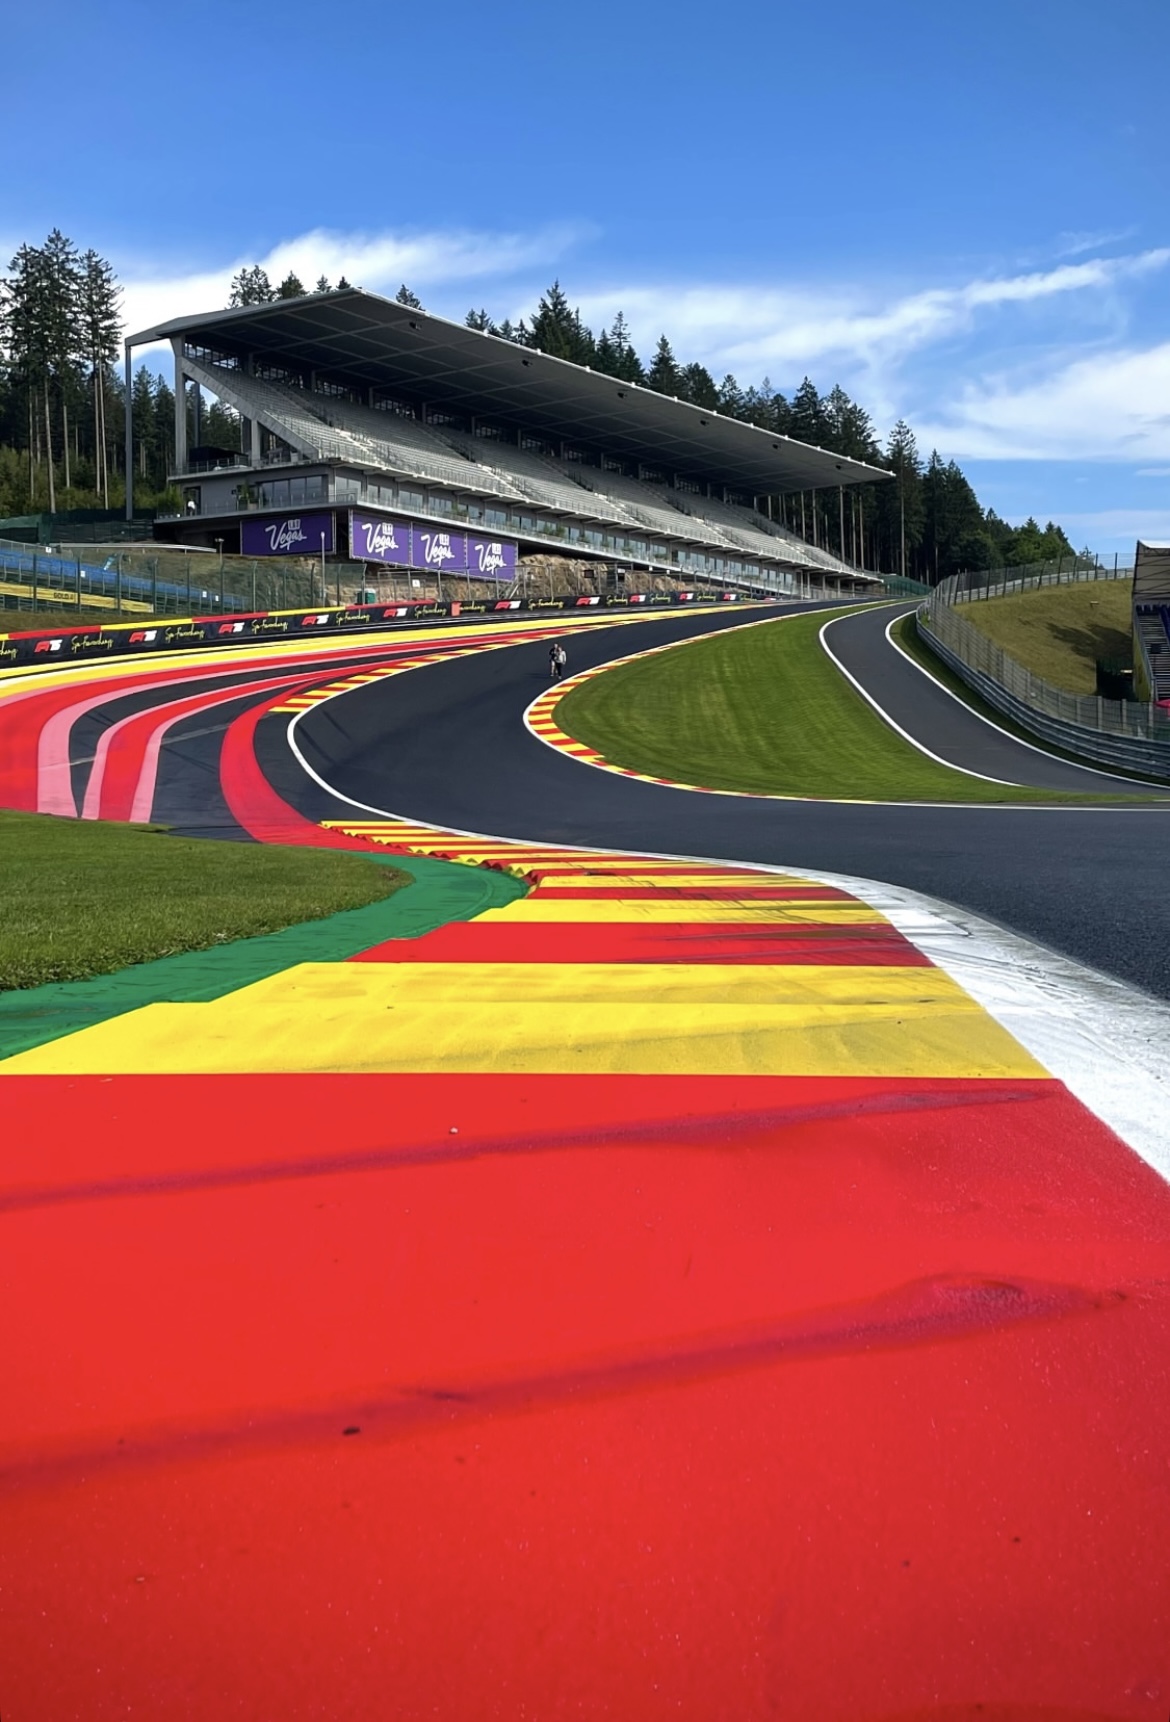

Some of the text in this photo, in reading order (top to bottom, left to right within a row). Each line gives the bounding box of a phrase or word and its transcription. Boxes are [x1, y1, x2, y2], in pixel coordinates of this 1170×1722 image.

[265, 522, 307, 550] Vegas
[362, 523, 399, 557] Vegas
[421, 534, 455, 567] Vegas
[475, 544, 507, 575] Vegas
